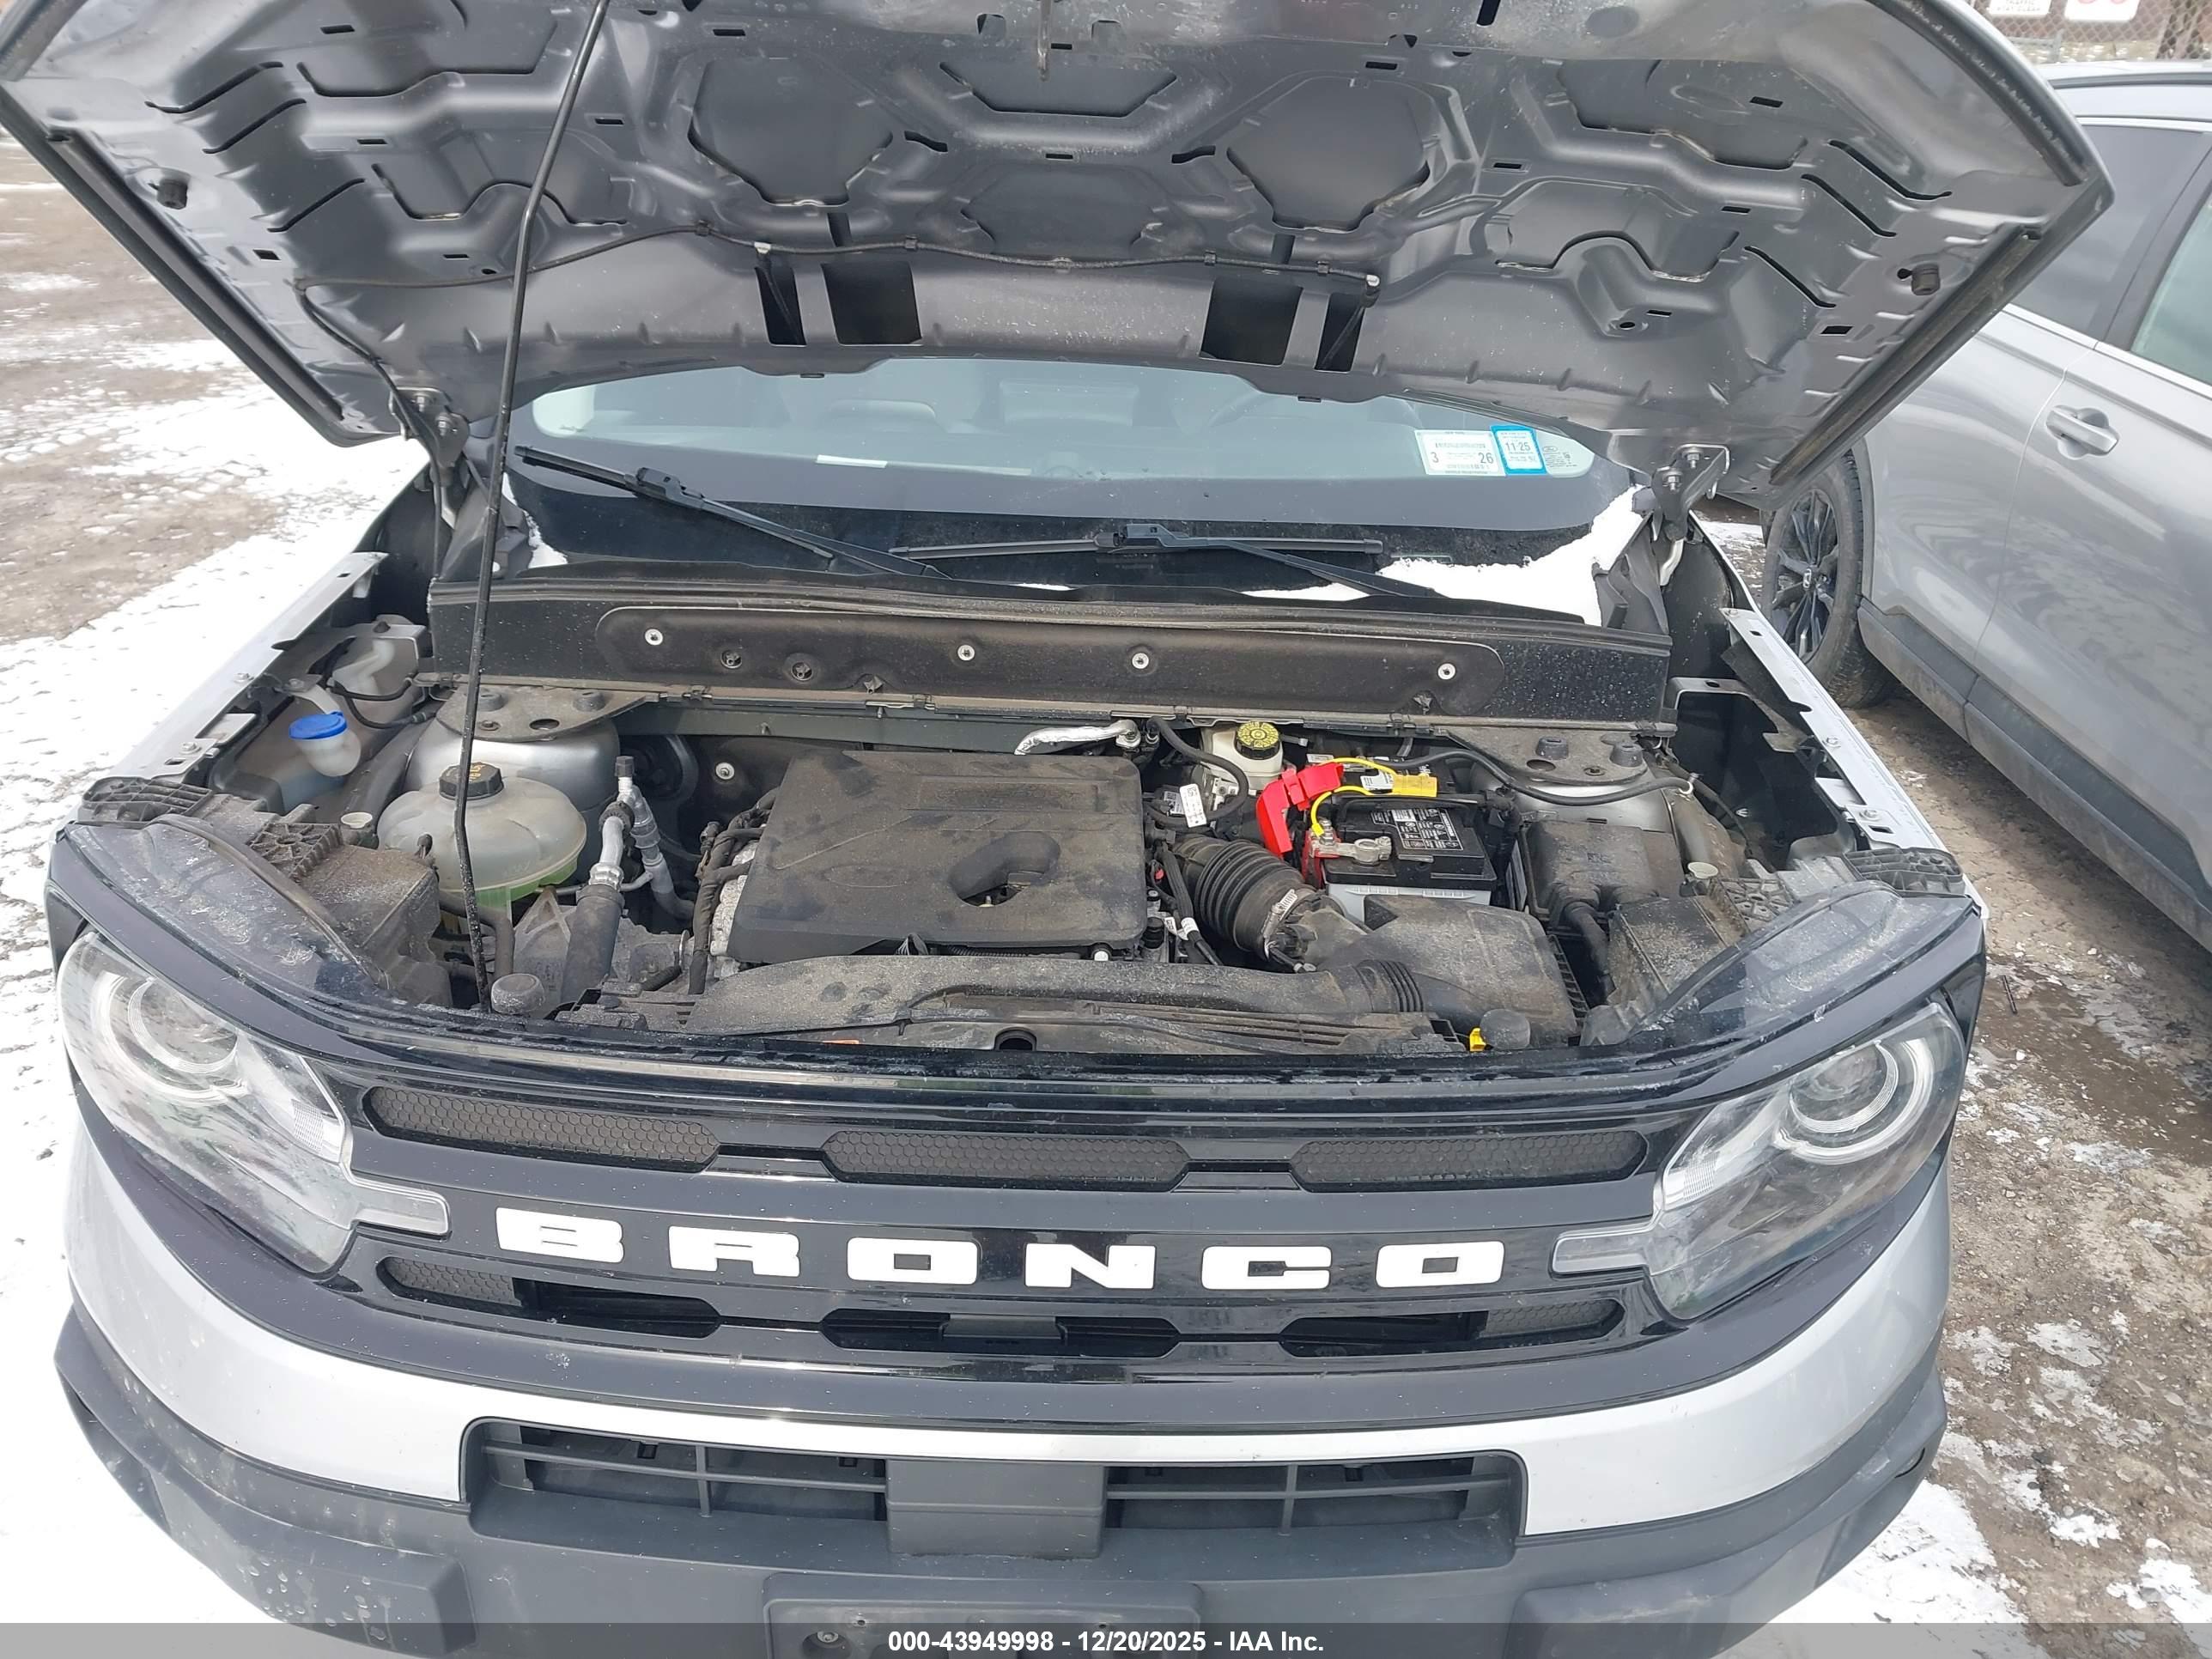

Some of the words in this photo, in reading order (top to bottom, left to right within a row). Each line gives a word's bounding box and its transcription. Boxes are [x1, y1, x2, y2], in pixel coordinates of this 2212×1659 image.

[1430, 451, 1440, 464] 3
[1478, 452, 1494, 465] 26
[495, 1206, 1505, 1291] BRONCO
